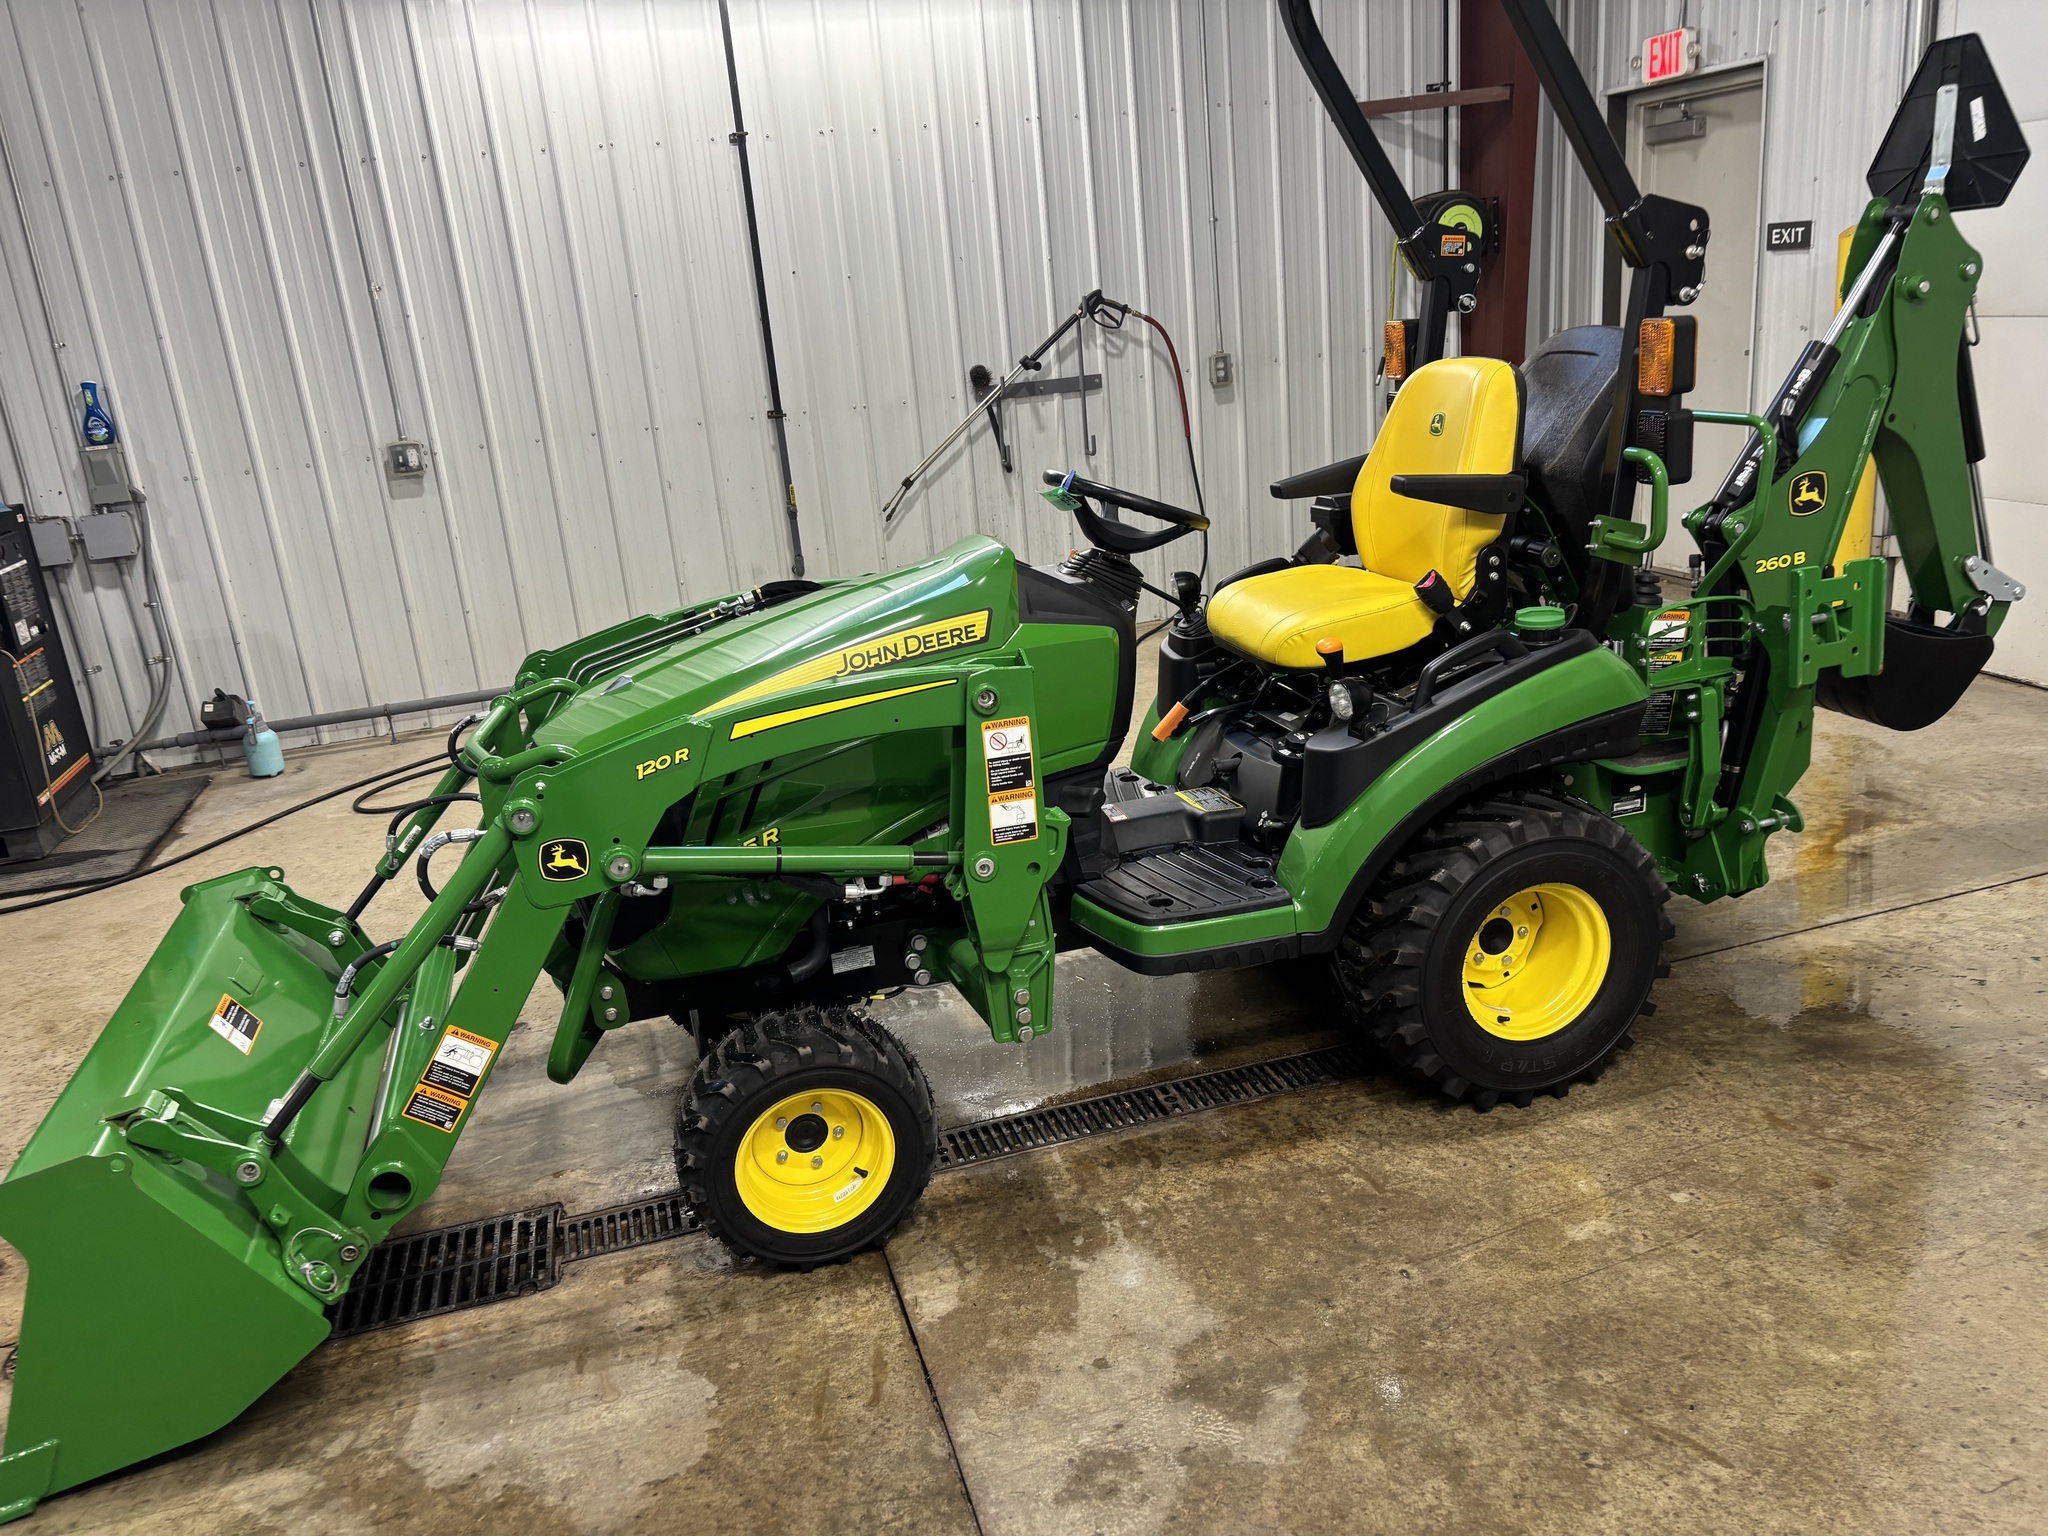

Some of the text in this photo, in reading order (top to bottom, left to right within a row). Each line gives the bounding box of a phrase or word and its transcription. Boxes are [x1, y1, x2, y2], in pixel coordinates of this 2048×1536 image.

[1649, 31, 1683, 79] EXIT
[1771, 227, 1805, 244] EXIT
[1755, 551, 1806, 574] 260 B
[836, 624, 978, 675] JOHN DEERE
[991, 717, 1027, 729] WARNING
[635, 747, 690, 781] 120 R
[997, 790, 1033, 802] WARNING
[458, 1031, 492, 1048] WARNING
[429, 1090, 462, 1106] WARNING
